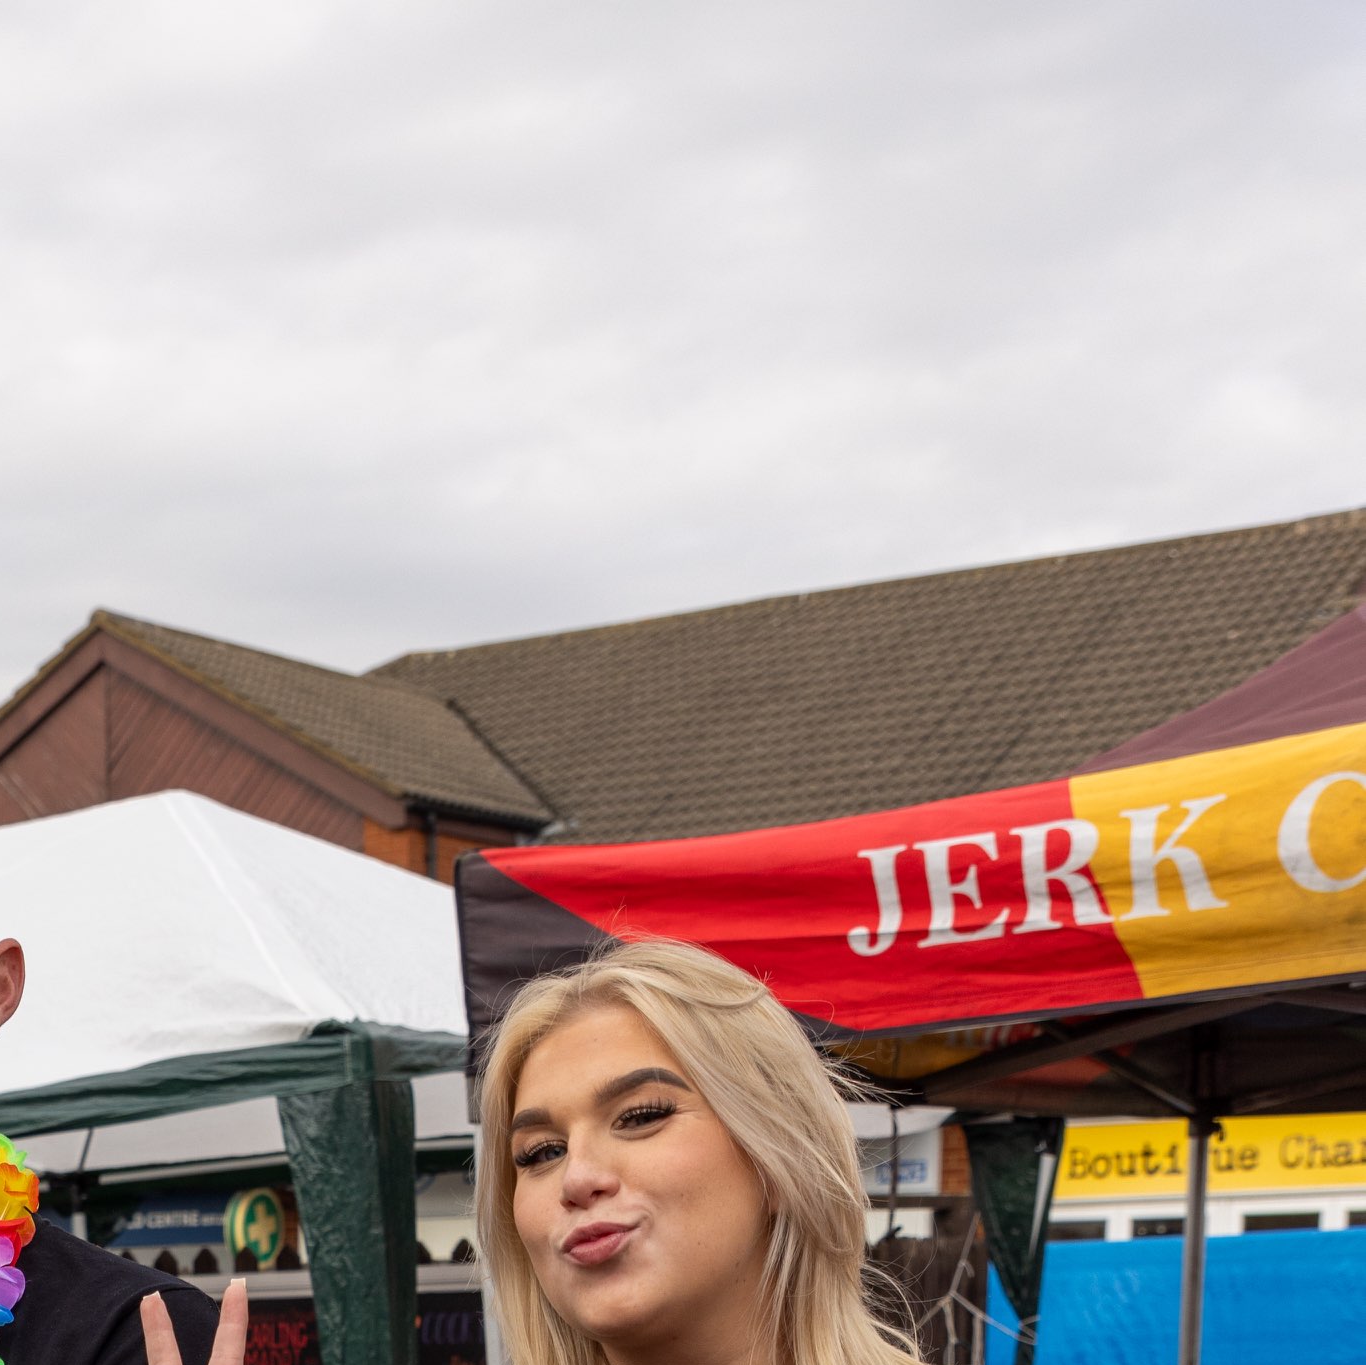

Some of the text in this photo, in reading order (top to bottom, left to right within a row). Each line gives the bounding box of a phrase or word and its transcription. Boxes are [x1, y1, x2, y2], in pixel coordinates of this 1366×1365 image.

[846, 794, 1230, 957] JERK
[1067, 1134, 1366, 1180] Boutiue Cha
